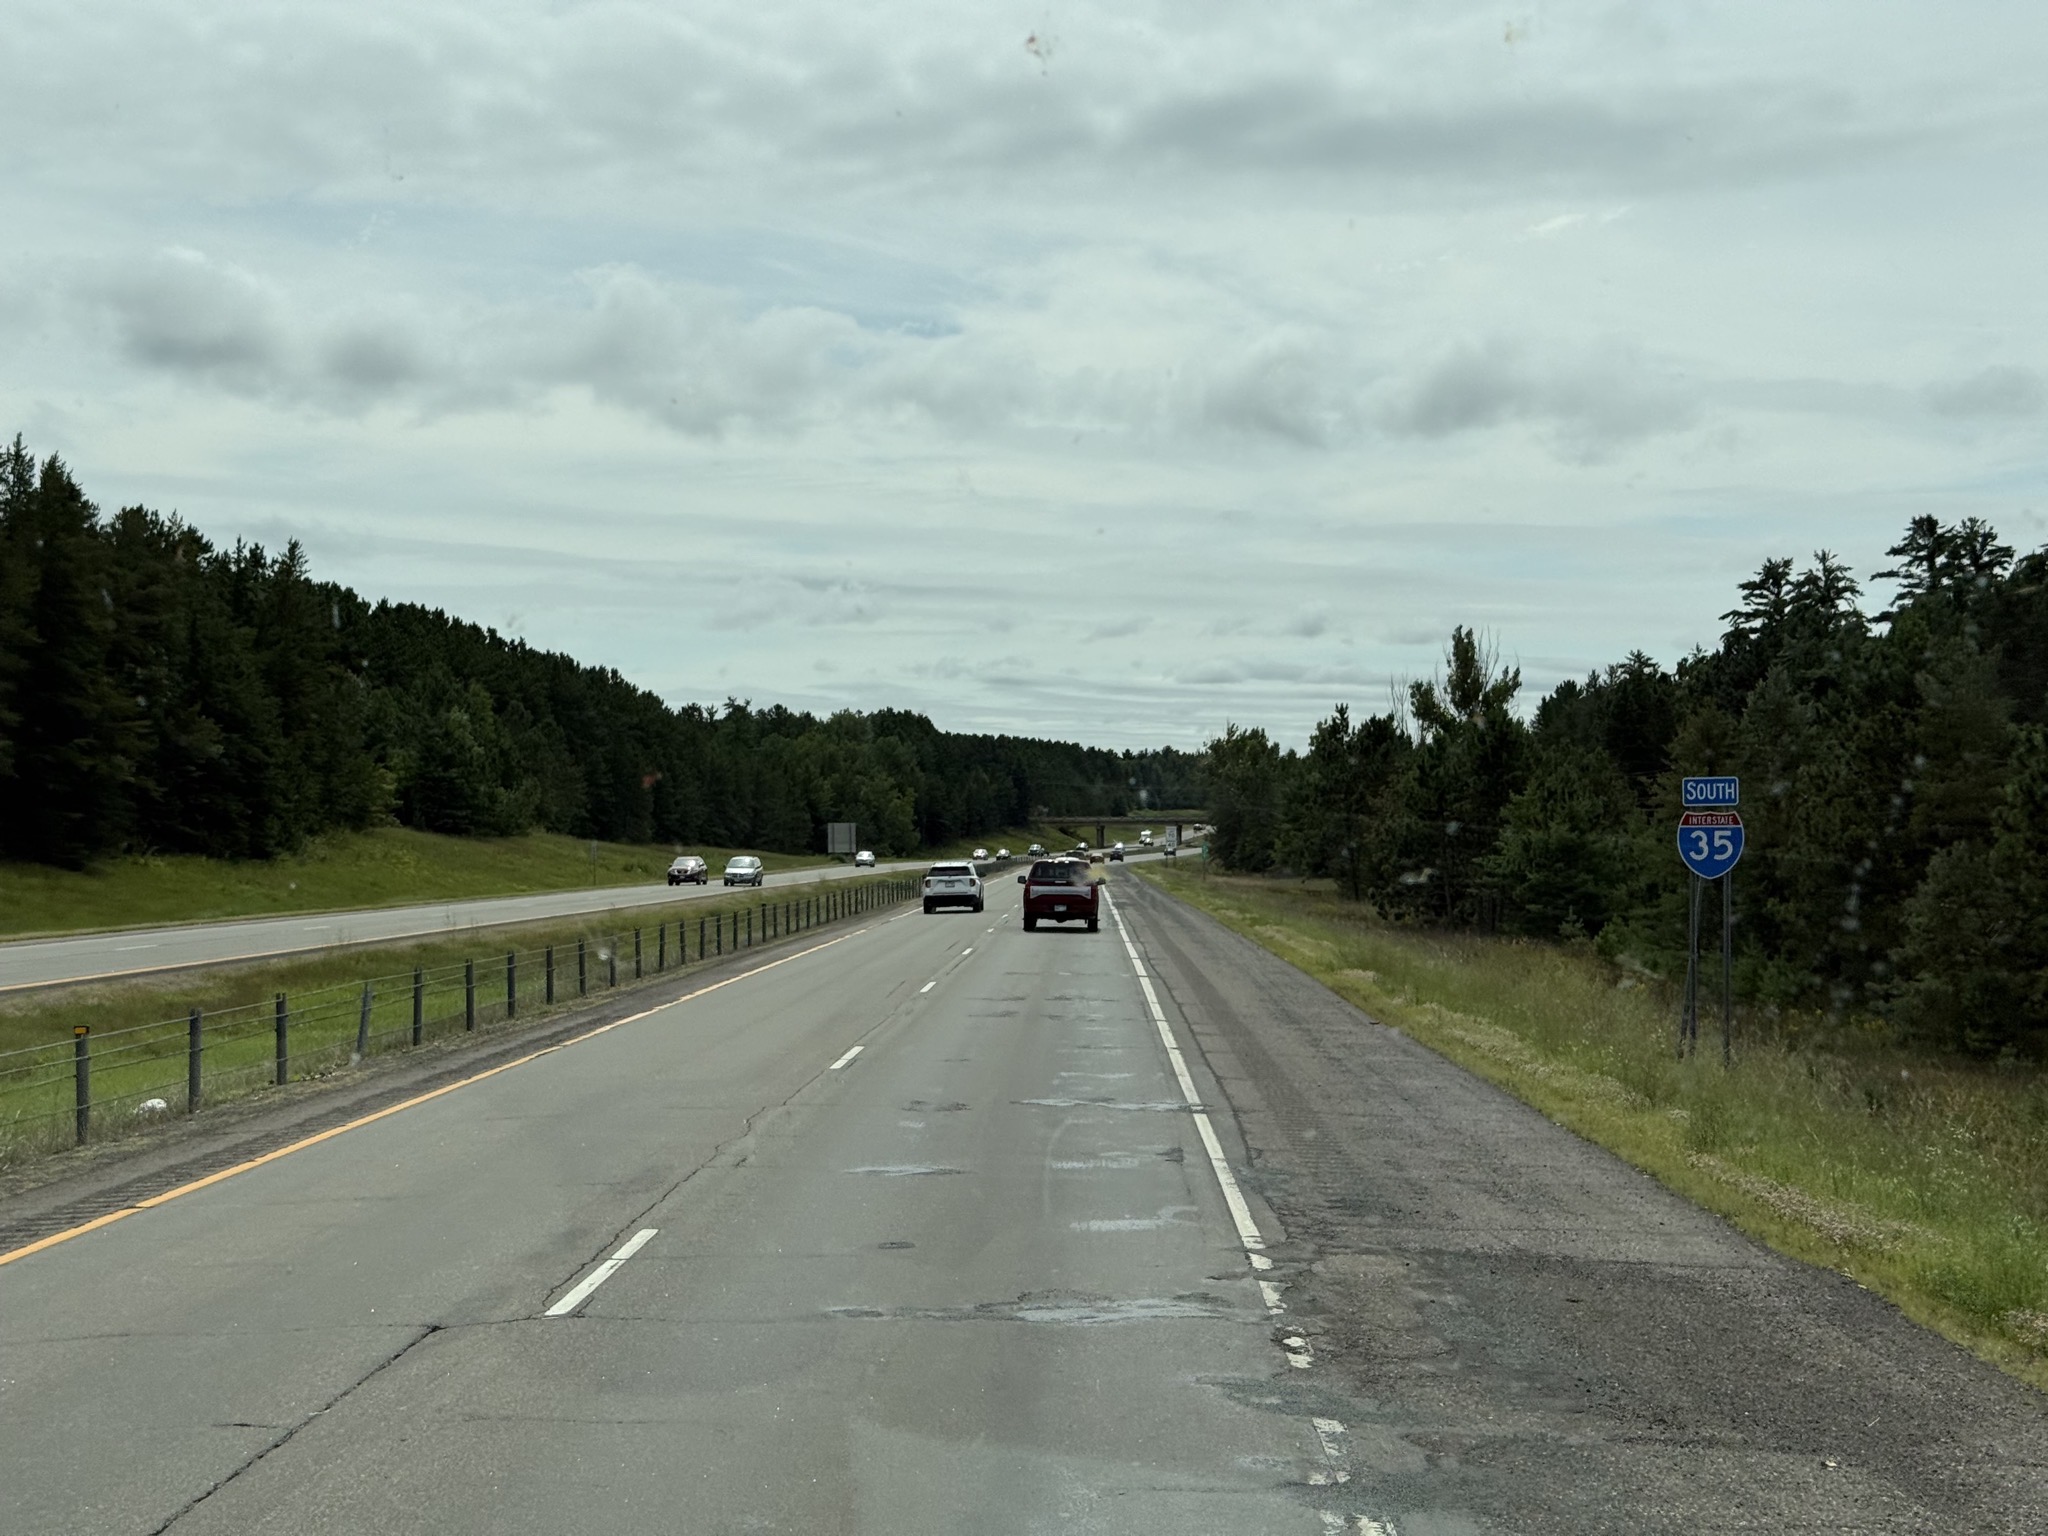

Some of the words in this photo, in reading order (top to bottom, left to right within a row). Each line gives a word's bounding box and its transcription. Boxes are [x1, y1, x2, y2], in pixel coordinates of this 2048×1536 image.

[1686, 781, 1735, 800] SOUTH
[1689, 816, 1734, 825] INTERSTATE
[1689, 830, 1733, 860] 35
